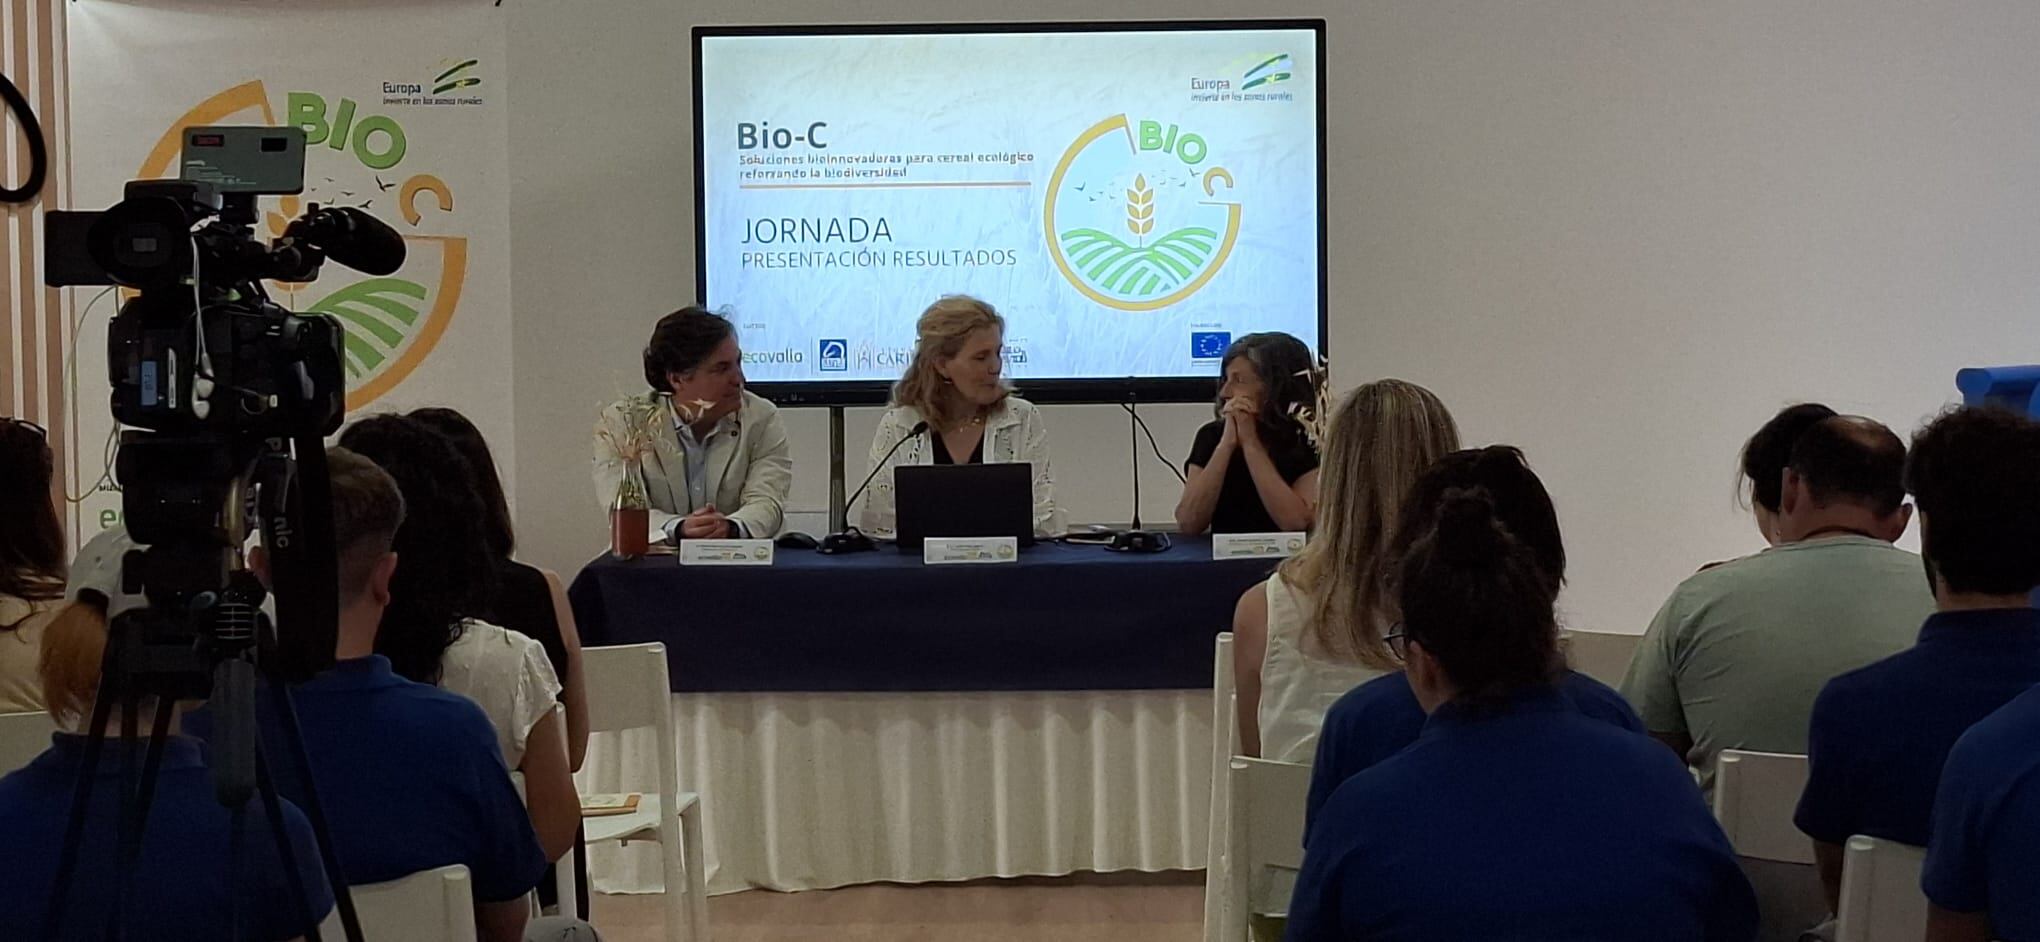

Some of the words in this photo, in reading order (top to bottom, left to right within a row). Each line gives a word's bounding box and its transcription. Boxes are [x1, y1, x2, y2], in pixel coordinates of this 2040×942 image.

[383, 82, 421, 96] Europa
[1191, 78, 1230, 93] Europa
[287, 92, 406, 169] BIO
[737, 121, 828, 150] Bio-C
[1139, 120, 1207, 164] BIO
[739, 154, 804, 166] Soluciones
[807, 153, 902, 165] bioinnovadoras
[906, 154, 934, 166] para
[937, 152, 974, 163] cereal
[977, 151, 1034, 165] ecológico
[739, 169, 807, 179] reforzando
[810, 168, 821, 178] la
[824, 166, 907, 178] biodiversidad
[741, 217, 893, 244] JORNADA
[742, 247, 886, 269] PRESENTACIÓN
[893, 249, 1017, 268] RESULTADOS
